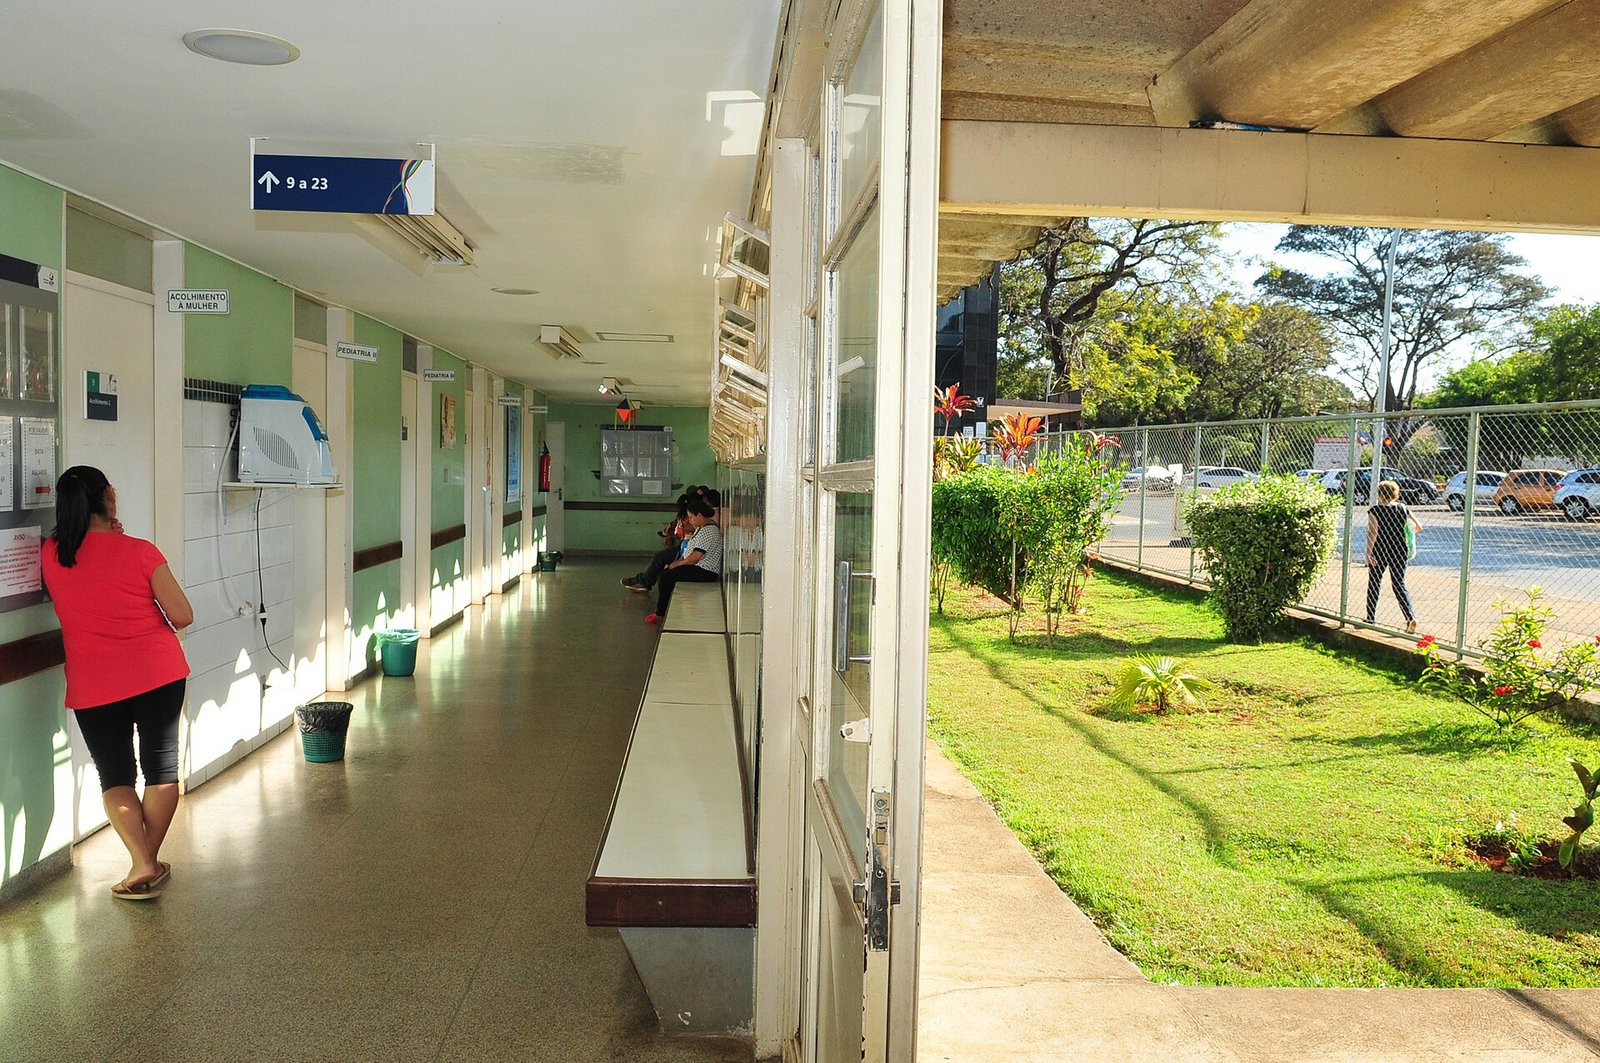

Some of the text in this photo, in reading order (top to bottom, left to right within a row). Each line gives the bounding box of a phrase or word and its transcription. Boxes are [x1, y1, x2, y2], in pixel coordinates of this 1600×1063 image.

[286, 176, 329, 190] 9 a 23
[170, 293, 226, 301] ACOLHIMENTO
[185, 302, 219, 310] MULHER
[337, 346, 372, 357] PEDIATRIA
